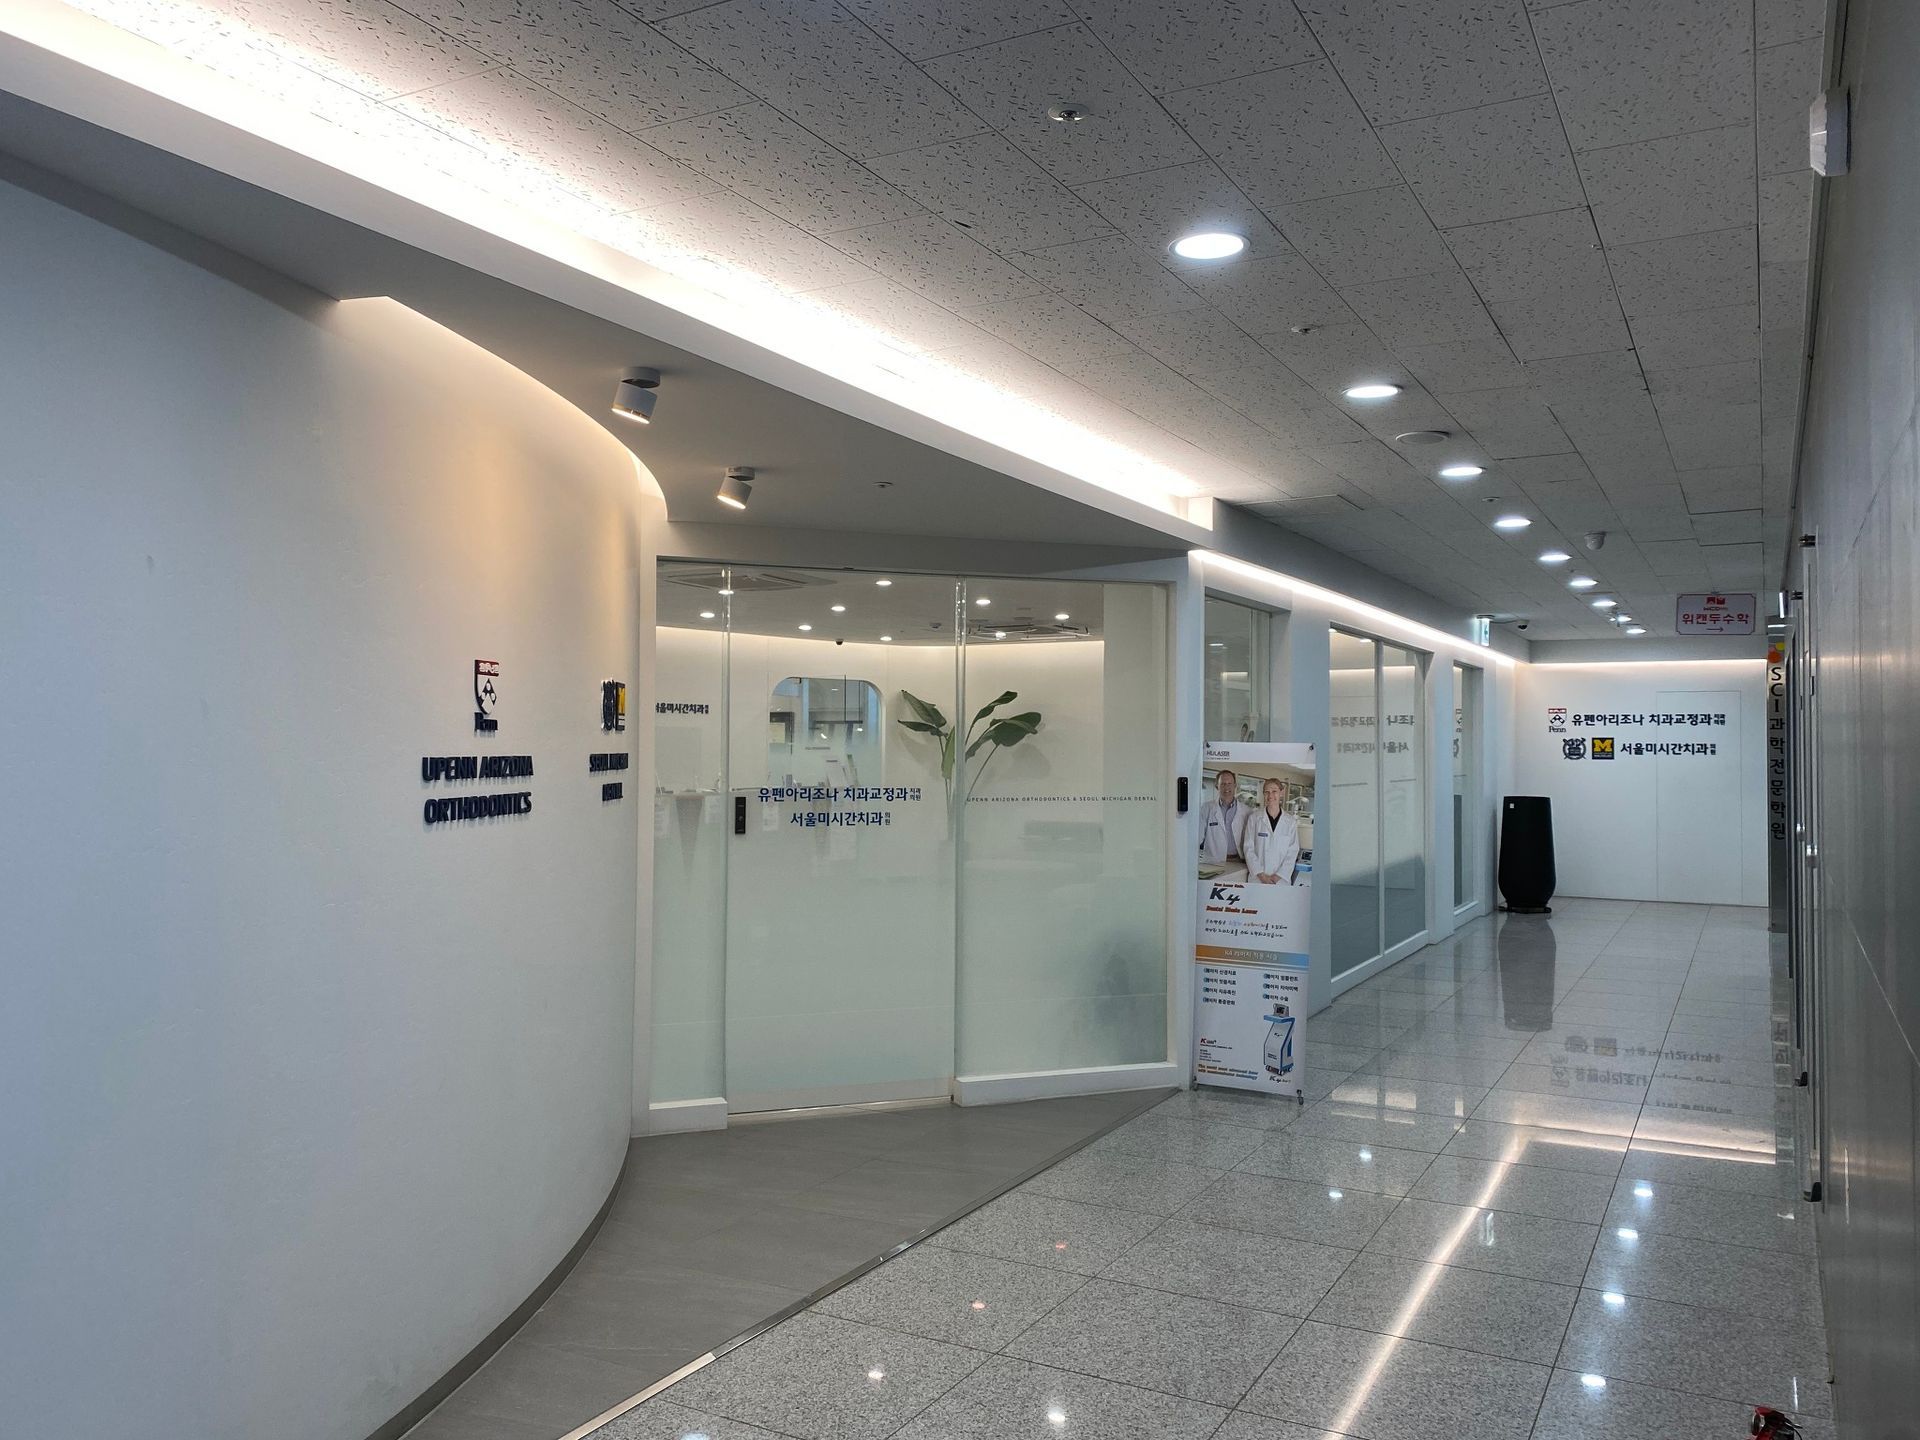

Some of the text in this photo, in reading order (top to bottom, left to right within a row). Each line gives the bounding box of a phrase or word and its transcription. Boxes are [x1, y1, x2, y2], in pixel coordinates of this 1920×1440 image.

[1571, 713, 1713, 727] 유펜아리조나 치과교정과
[1620, 743, 1709, 756] 서울미시간치과
[422, 755, 534, 782] UPENN ARIZONA
[758, 787, 909, 802] 유펜아리조나 치과교정과
[424, 791, 532, 824] ORTHODONTICS
[790, 812, 884, 827] 서울미시간치과
